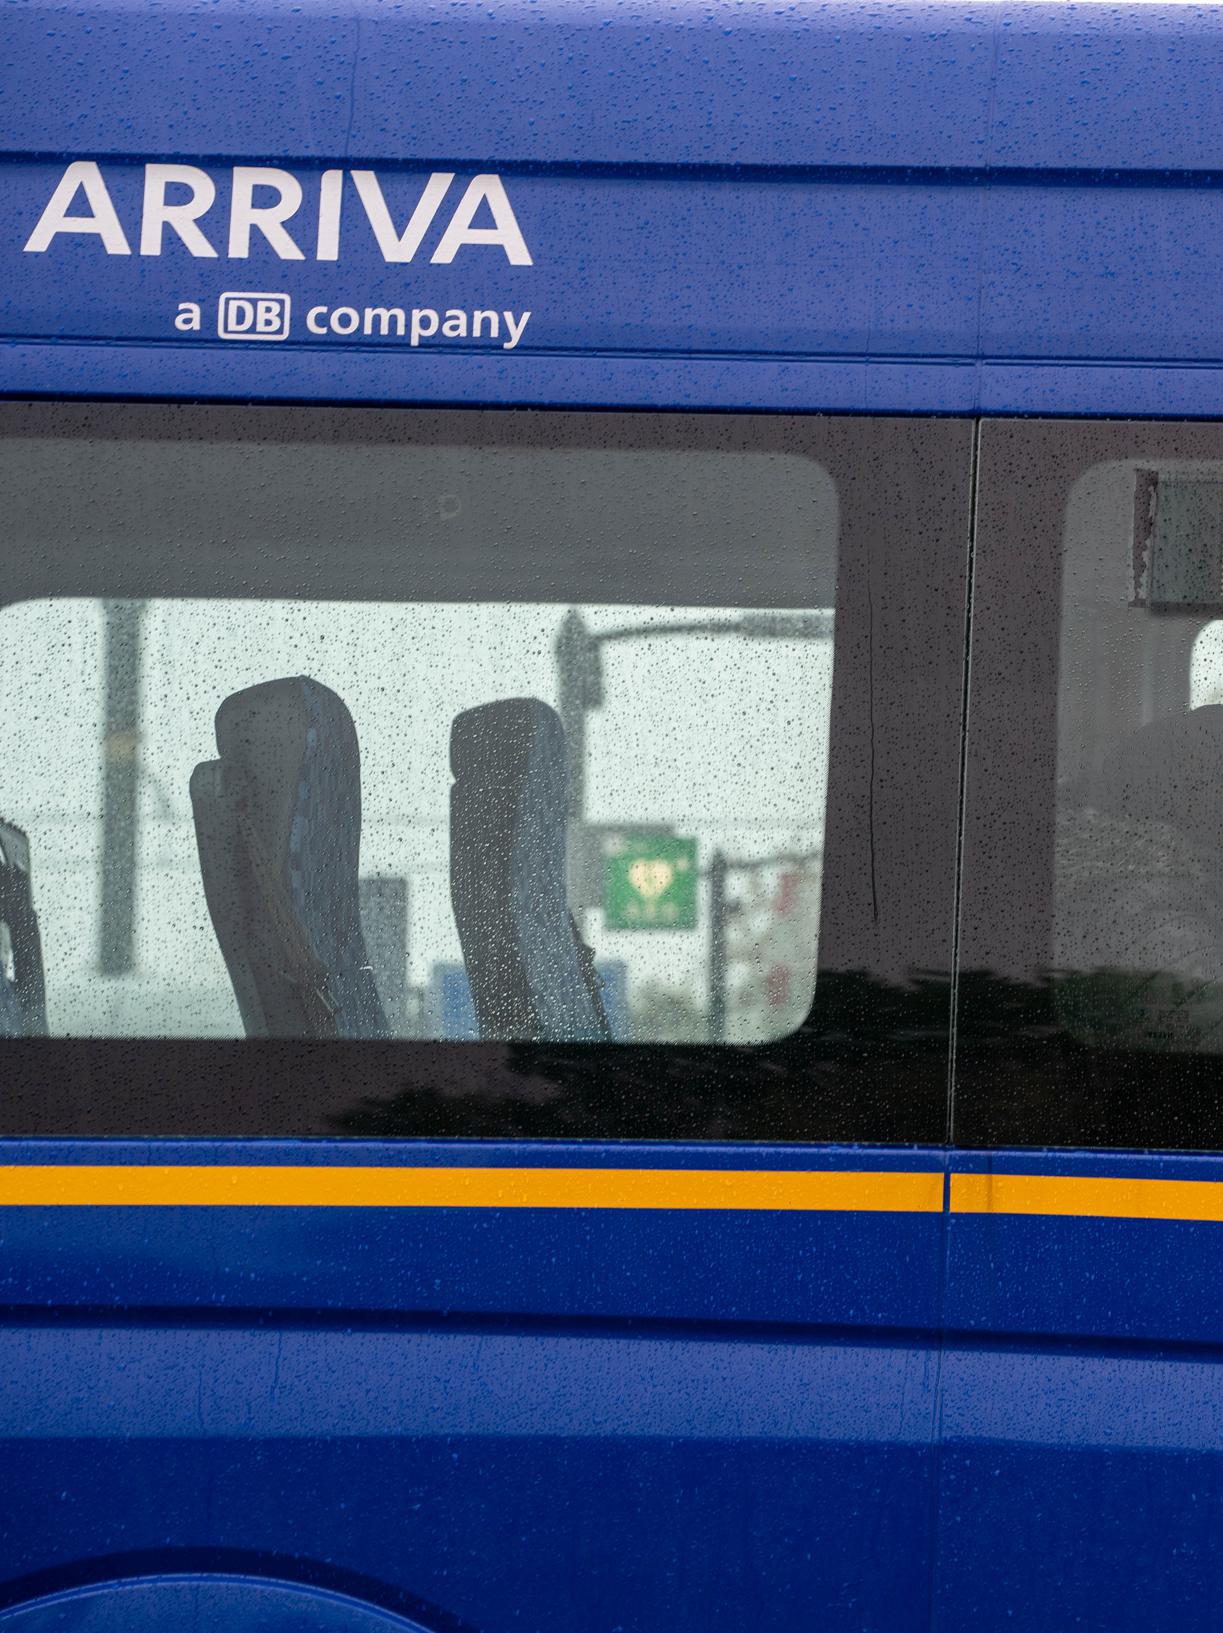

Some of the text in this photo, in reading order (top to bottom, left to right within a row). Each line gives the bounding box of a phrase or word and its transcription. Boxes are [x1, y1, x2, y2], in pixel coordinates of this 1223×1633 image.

[23, 161, 534, 266] ARRIVA
[174, 297, 532, 349] a DB company
